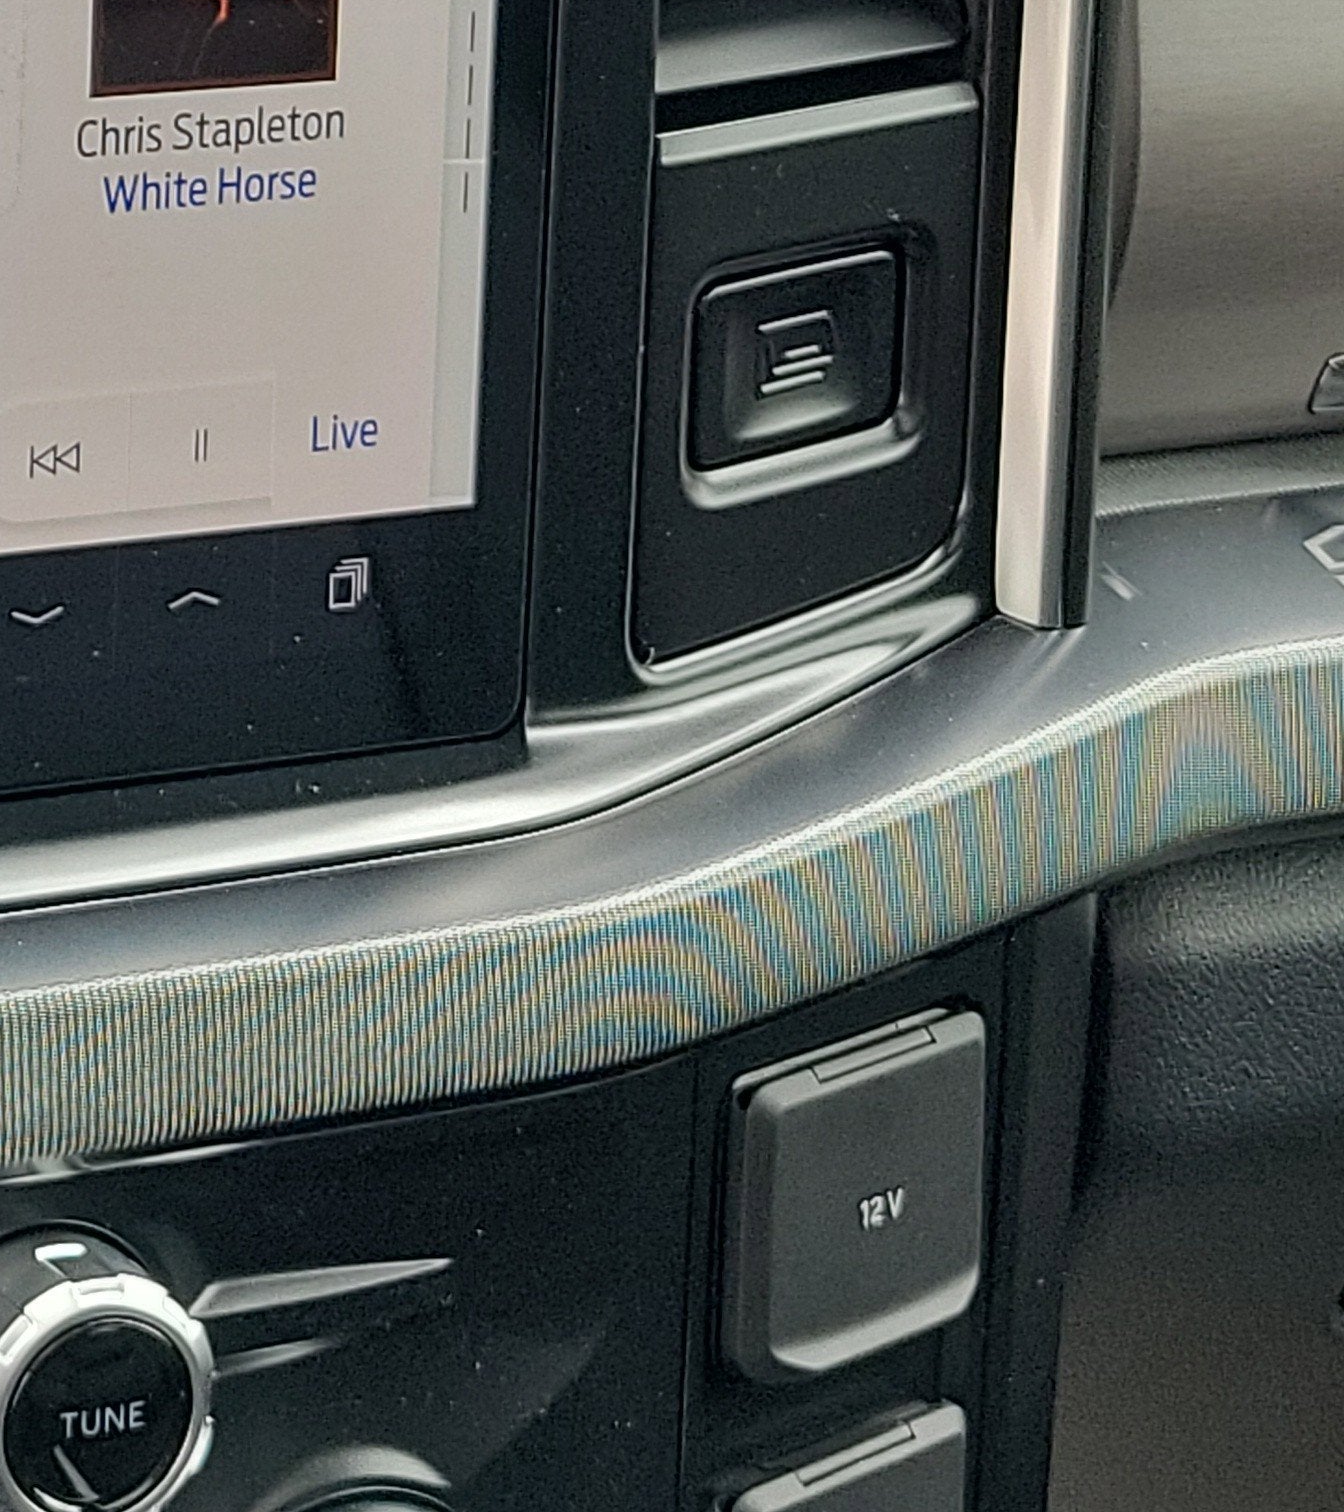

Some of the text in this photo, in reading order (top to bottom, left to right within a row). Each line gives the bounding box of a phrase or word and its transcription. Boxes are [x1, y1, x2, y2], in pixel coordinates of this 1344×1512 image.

[76, 106, 345, 158] Chris Stapleton
[103, 167, 317, 214] White Horse
[312, 414, 378, 454] Live
[859, 1187, 904, 1230] 12V
[59, 1400, 146, 1439] TUNE
